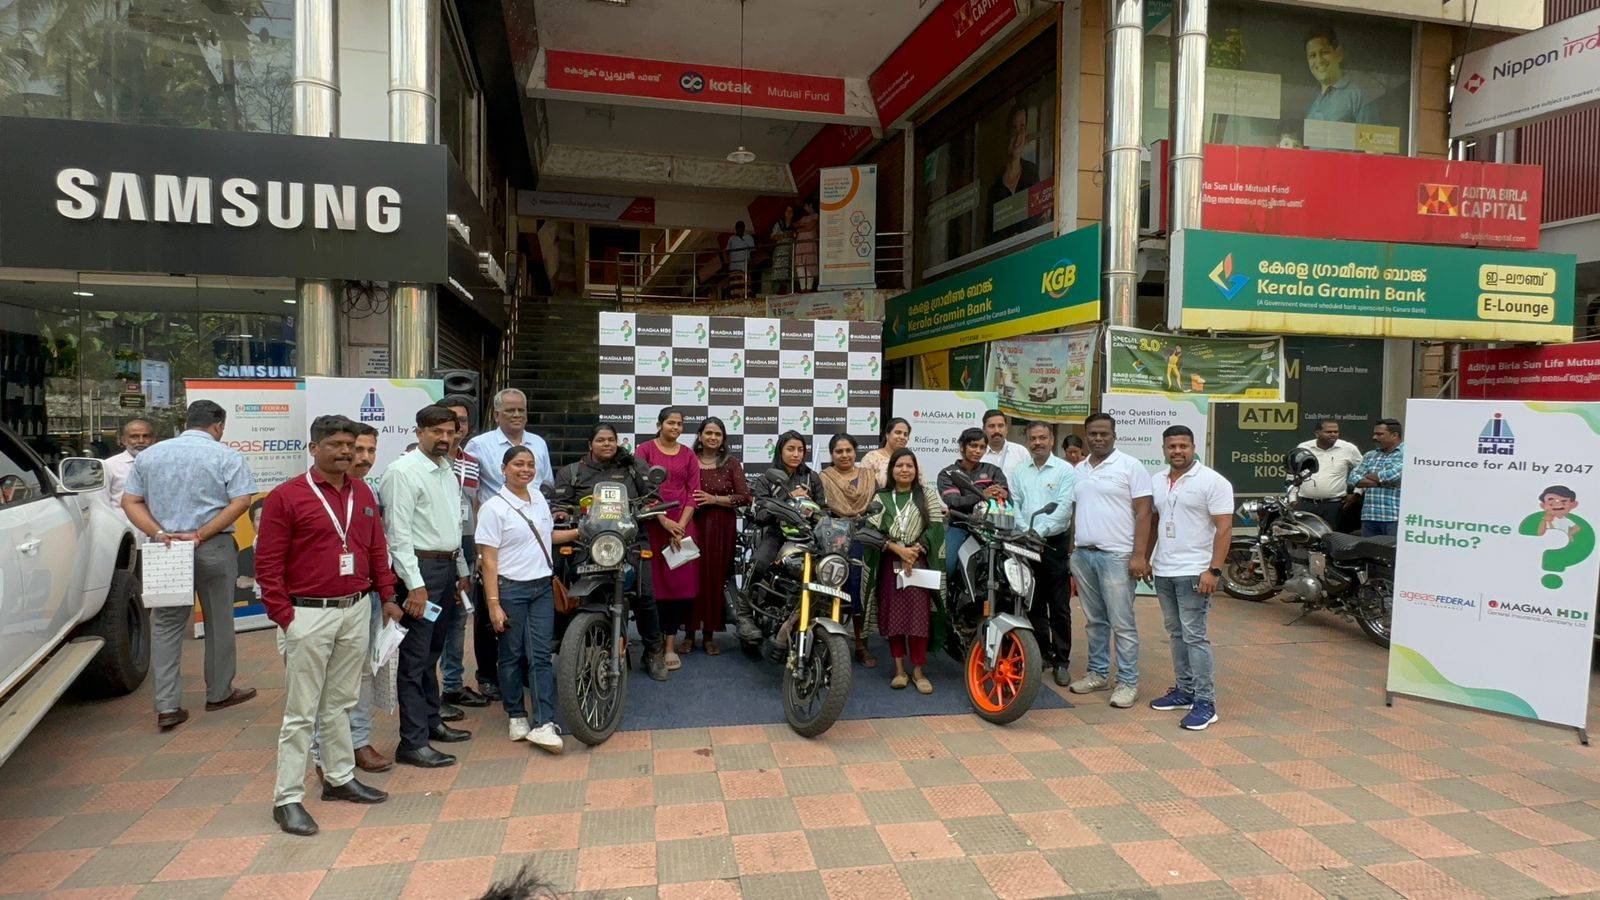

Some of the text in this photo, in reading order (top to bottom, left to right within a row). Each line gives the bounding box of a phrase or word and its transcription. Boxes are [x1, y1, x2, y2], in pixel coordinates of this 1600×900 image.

[1493, 50, 1559, 80] Nippon
[709, 79, 830, 102] kotak Mutual Fund
[1213, 182, 1228, 191] Sun
[1229, 183, 1243, 191] Life
[1245, 184, 1270, 193] Mutual
[1271, 185, 1290, 194] Fund
[1462, 187, 1528, 202] ADITYA BIRLA
[56, 167, 402, 234] SAMSUNG
[1461, 200, 1527, 221] CAPITAL
[1258, 260, 1427, 282] കേരള ഗ്രാമീൺ ബാങ്ക്
[1041, 264, 1077, 294] KGB
[1257, 279, 1426, 302] Kerala Gramin Bank
[1264, 300, 1298, 309] Government
[1484, 298, 1549, 317] E-Lounge
[908, 298, 992, 332] Kerala Gramin Bank
[1139, 338, 1161, 352] 3.0
[217, 364, 297, 378] SAMSUN
[1339, 365, 1355, 373] Cash
[1355, 366, 1369, 374] here
[1468, 358, 1600, 373] Aditya Birla Sun Life Mutua
[261, 404, 288, 412] FEDERAL
[920, 411, 976, 419] MAGMA HDI
[1108, 409, 1126, 417] One
[1129, 409, 1166, 417] Question
[1242, 408, 1294, 423] ATM
[360, 412, 385, 421] irdai
[1305, 412, 1317, 420] Cash
[398, 426, 411, 435] by
[221, 440, 307, 452] easFEDER
[914, 436, 939, 445] Riding
[1231, 451, 1286, 463] Passbo
[1478, 444, 1514, 455] irdai
[1254, 465, 1287, 477] KIOS
[1413, 457, 1594, 474] Insurance for All by 2047
[1405, 513, 1512, 535] #Insurance
[1404, 530, 1481, 549] Edutho?
[1487, 610, 1573, 627] General Insurance Company
[1500, 602, 1589, 621] MAGMA HDI
